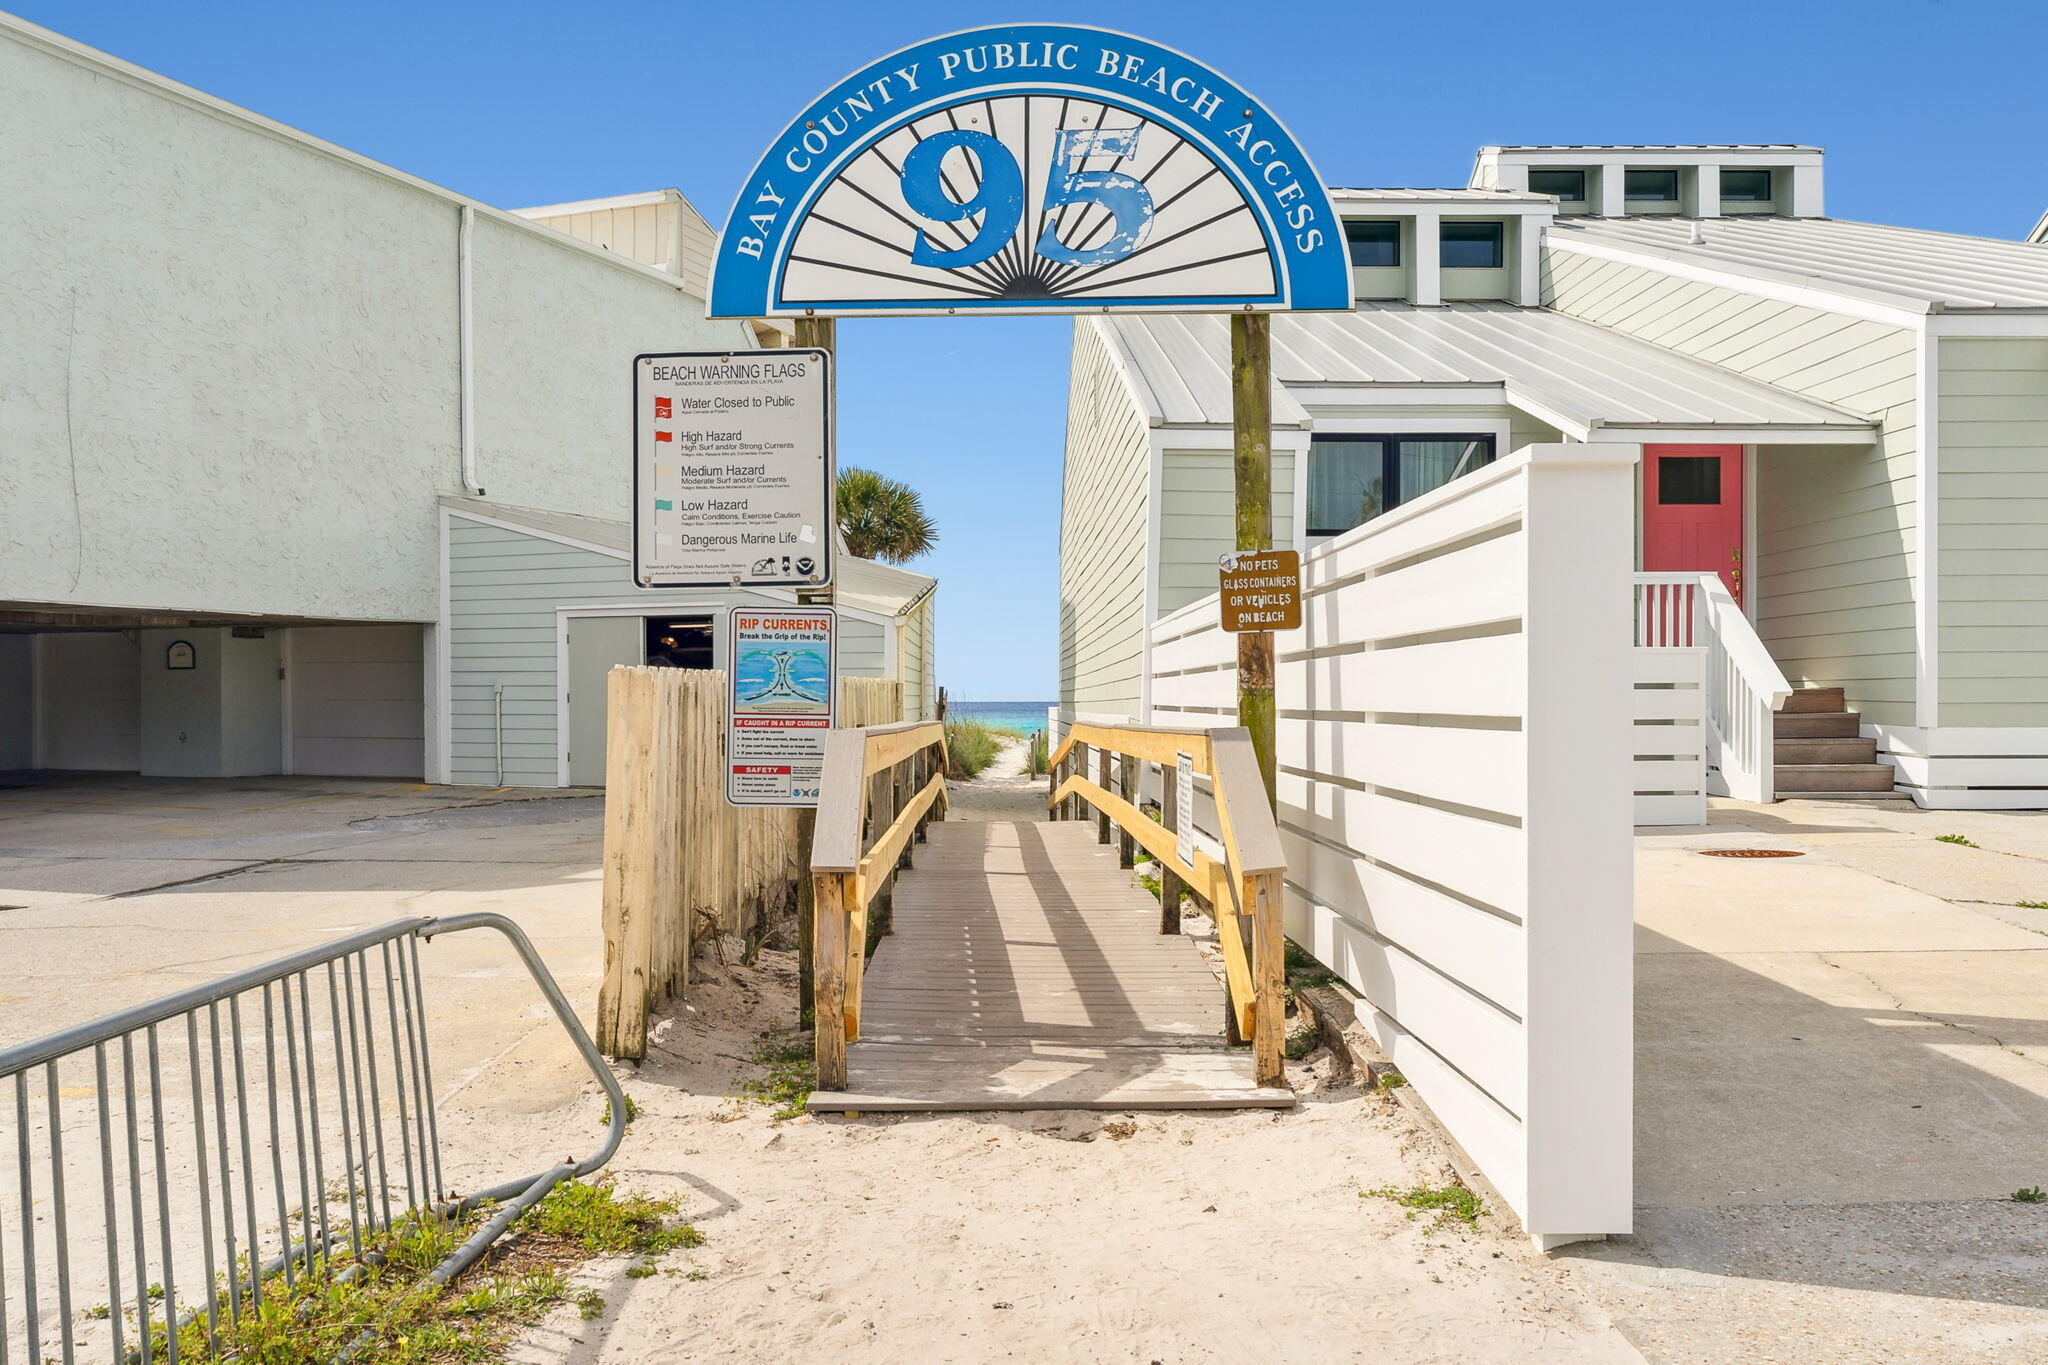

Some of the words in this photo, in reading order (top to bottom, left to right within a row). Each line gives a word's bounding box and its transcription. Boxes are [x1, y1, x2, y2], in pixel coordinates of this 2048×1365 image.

[736, 180, 786, 262] BAY
[785, 62, 921, 173] COUNTY
[938, 43, 1079, 81] PUBLIC
[1095, 48, 1225, 122] BEACH
[1224, 121, 1324, 254] ACCESS
[900, 126, 1155, 268] 95
[653, 366, 695, 381] BEACH
[700, 365, 760, 379] WARNING
[764, 363, 806, 378] FLAGS
[682, 398, 711, 409] Water
[714, 397, 749, 408] Closed
[752, 397, 762, 407] to
[765, 395, 795, 407] Public
[681, 431, 703, 444] High
[706, 430, 742, 442] Hazard
[681, 466, 722, 477] Medium
[726, 465, 765, 475] Hazard
[681, 500, 704, 511] Low
[708, 499, 748, 510] Hazard
[681, 534, 738, 547] Dangerous
[741, 533, 776, 544] Marine
[779, 532, 797, 543] Life
[1240, 561, 1253, 571] NO
[1255, 560, 1278, 570] PETS
[1224, 578, 1248, 590] GLASS
[1250, 576, 1296, 587] CONTAINERS
[1230, 596, 1243, 606] OR
[1246, 594, 1291, 607] VEHICLES
[740, 618, 759, 629] RIP
[763, 619, 827, 630] CURRENTS
[1238, 613, 1251, 623] ON
[1254, 611, 1284, 623] BEACH
